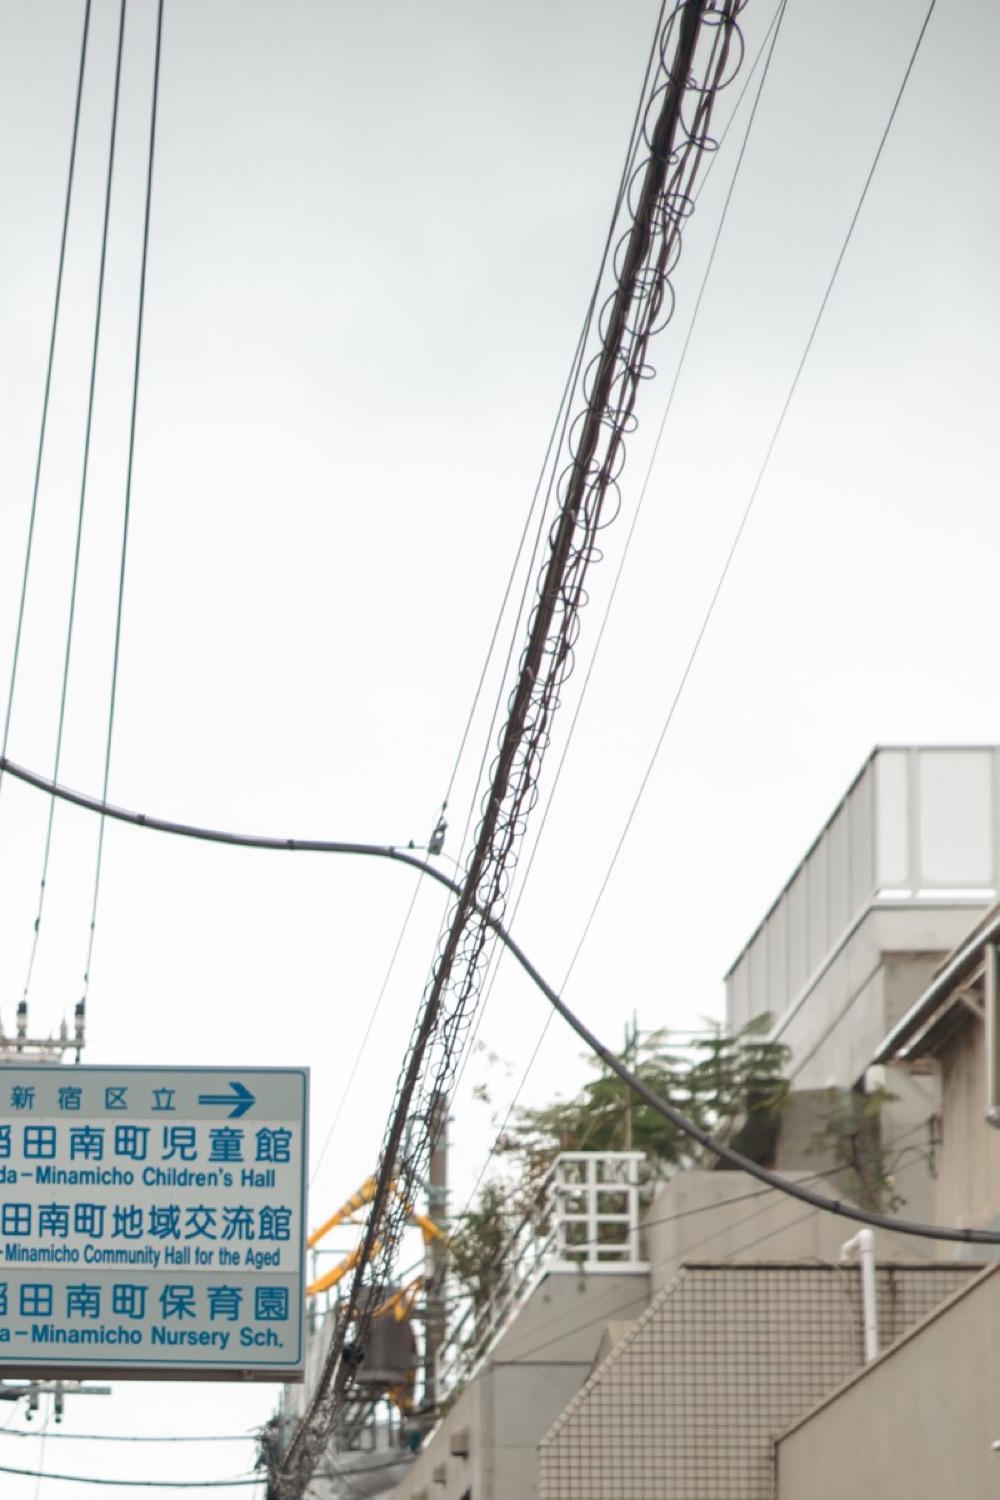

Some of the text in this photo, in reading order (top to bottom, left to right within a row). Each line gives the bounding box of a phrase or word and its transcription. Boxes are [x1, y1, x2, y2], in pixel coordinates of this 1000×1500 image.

[10, 1085, 176, 1111] 新宿区立
[142, 1167, 233, 1188] Children's
[241, 1168, 276, 1188] Hall
[83, 1245, 160, 1269] Community
[164, 1246, 191, 1265] Hall
[194, 1246, 214, 1266] for
[219, 1247, 240, 1266] the
[245, 1248, 280, 1270] Aged
[151, 1326, 230, 1350] Nursery
[240, 1328, 284, 1348] Sch.
